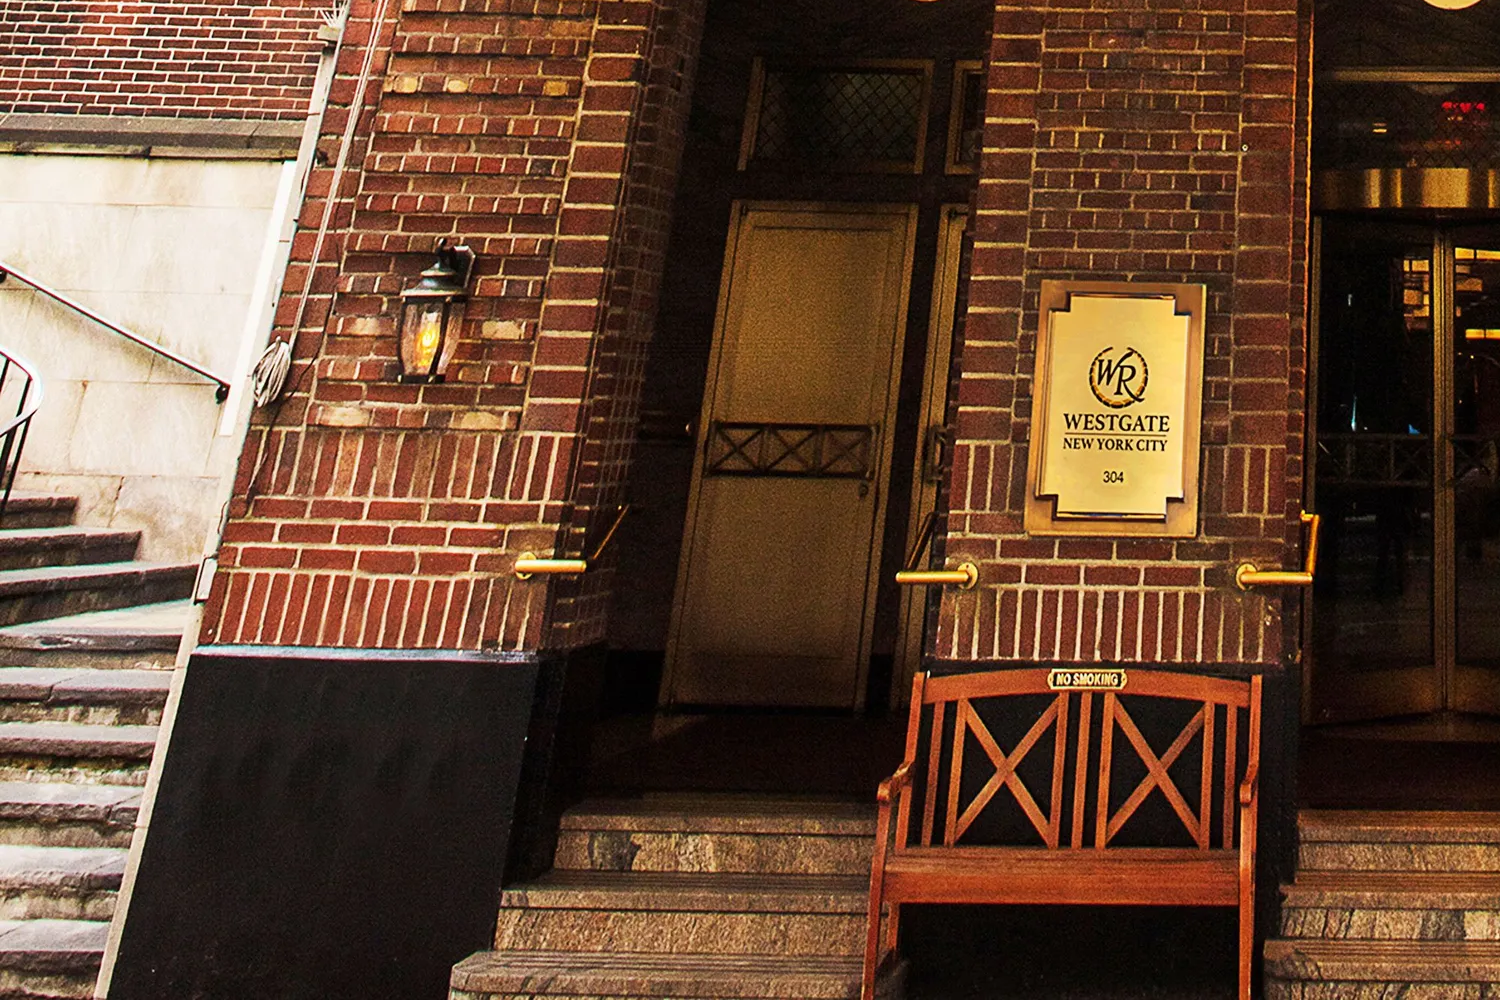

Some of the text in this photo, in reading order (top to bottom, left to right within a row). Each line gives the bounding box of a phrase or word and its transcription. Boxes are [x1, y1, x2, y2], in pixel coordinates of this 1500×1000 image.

[1063, 413, 1170, 433] WESTGATE
[1063, 437, 1169, 452] NEW YORK CITY
[1103, 470, 1124, 484] 304
[1056, 673, 1118, 686] NO SMOKING
